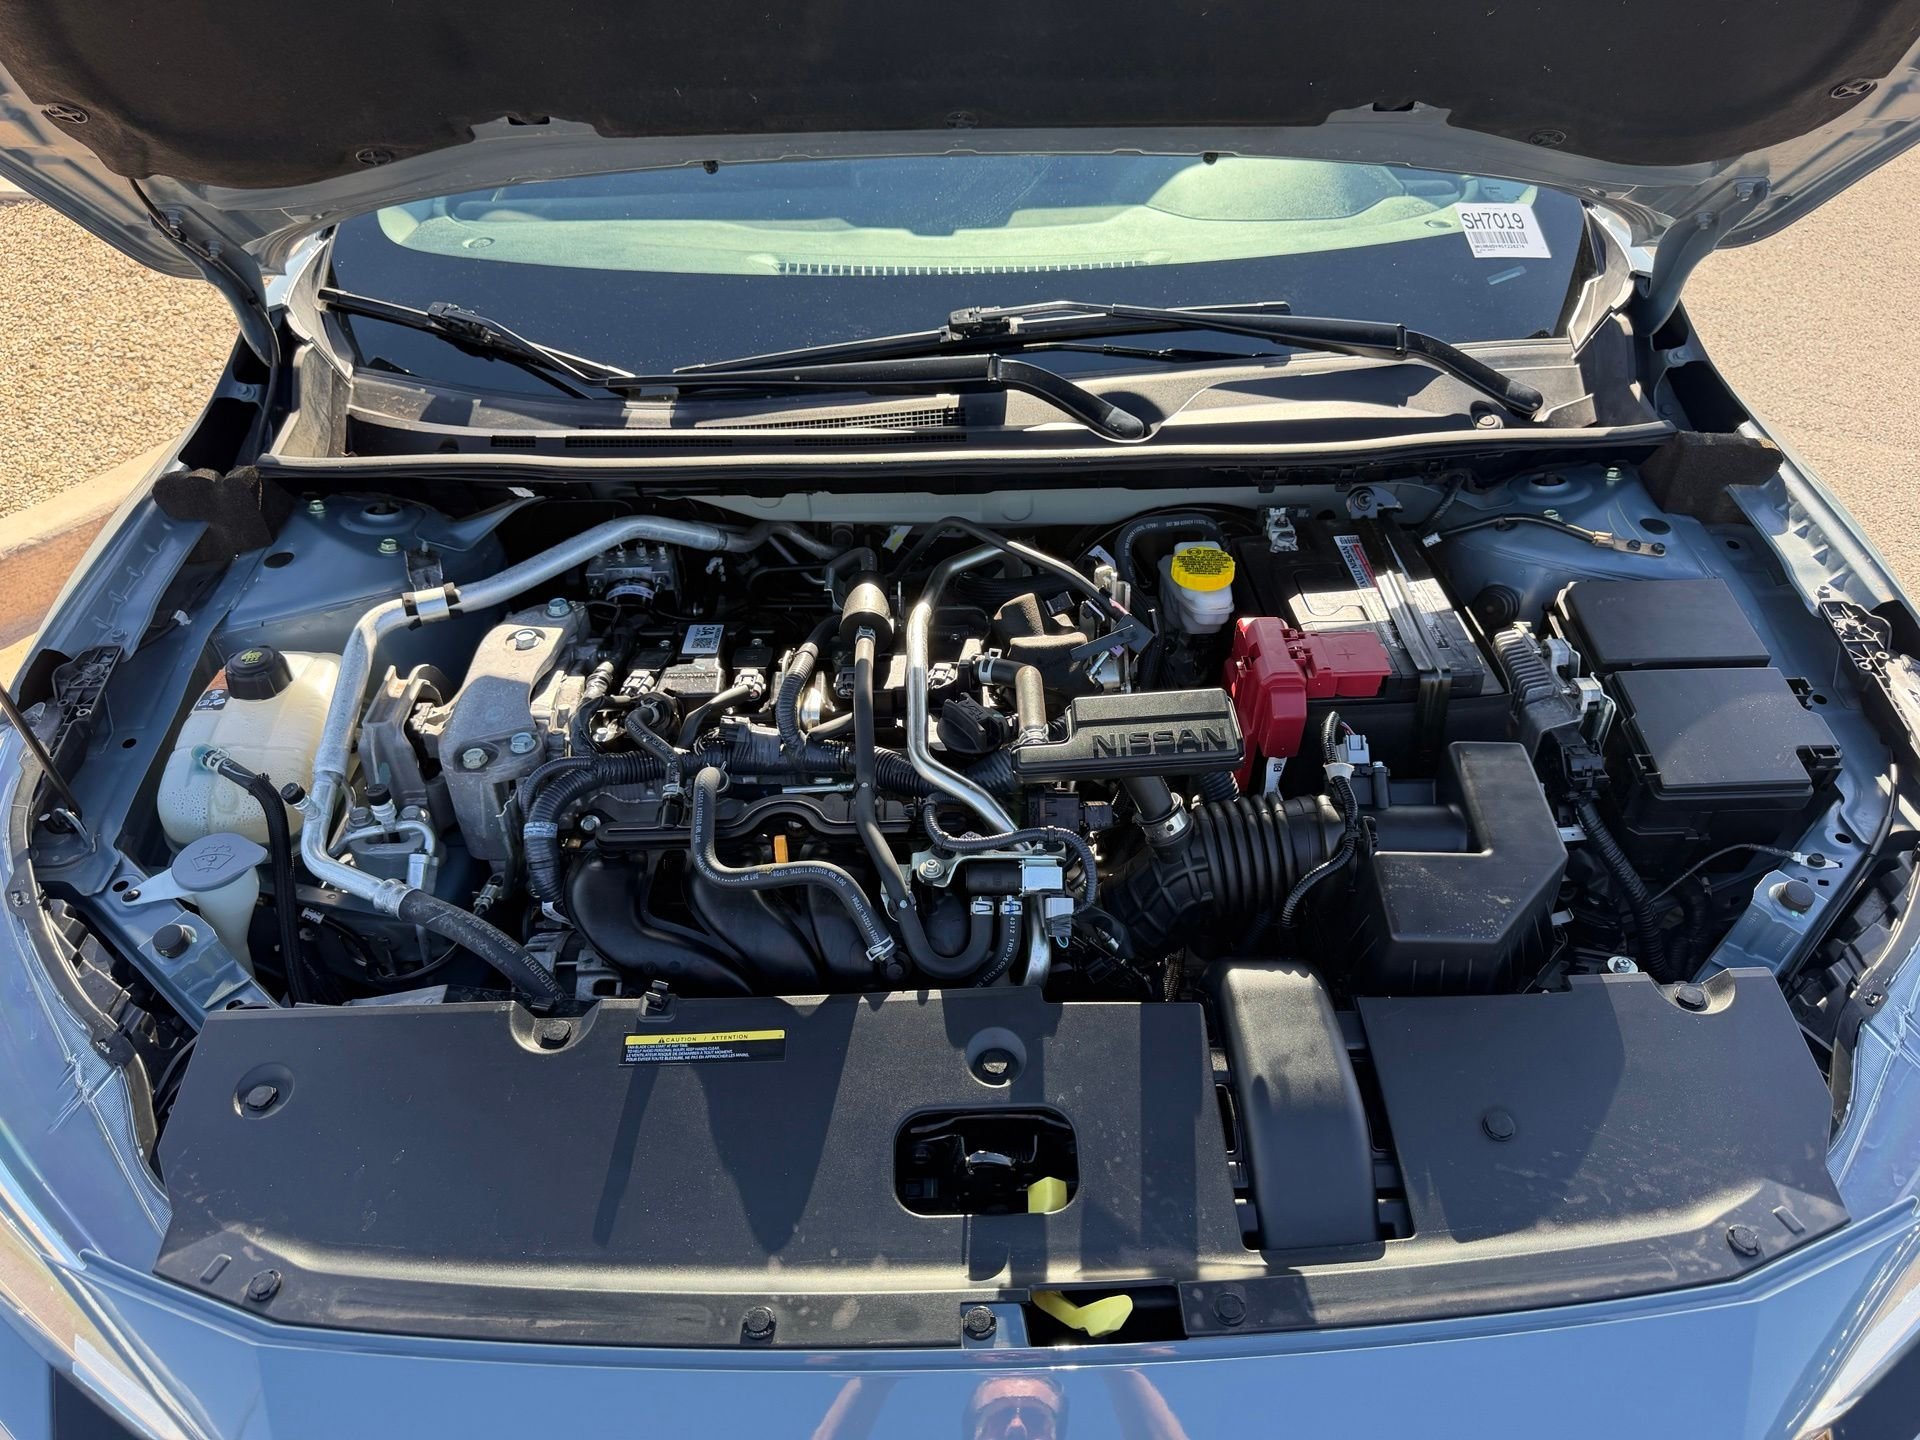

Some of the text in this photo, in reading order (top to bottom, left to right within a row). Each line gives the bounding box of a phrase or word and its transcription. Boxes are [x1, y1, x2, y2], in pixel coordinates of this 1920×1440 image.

[1462, 212, 1524, 230] SH7019
[700, 626, 716, 636] 3A
[1092, 726, 1228, 759] NISSAN
